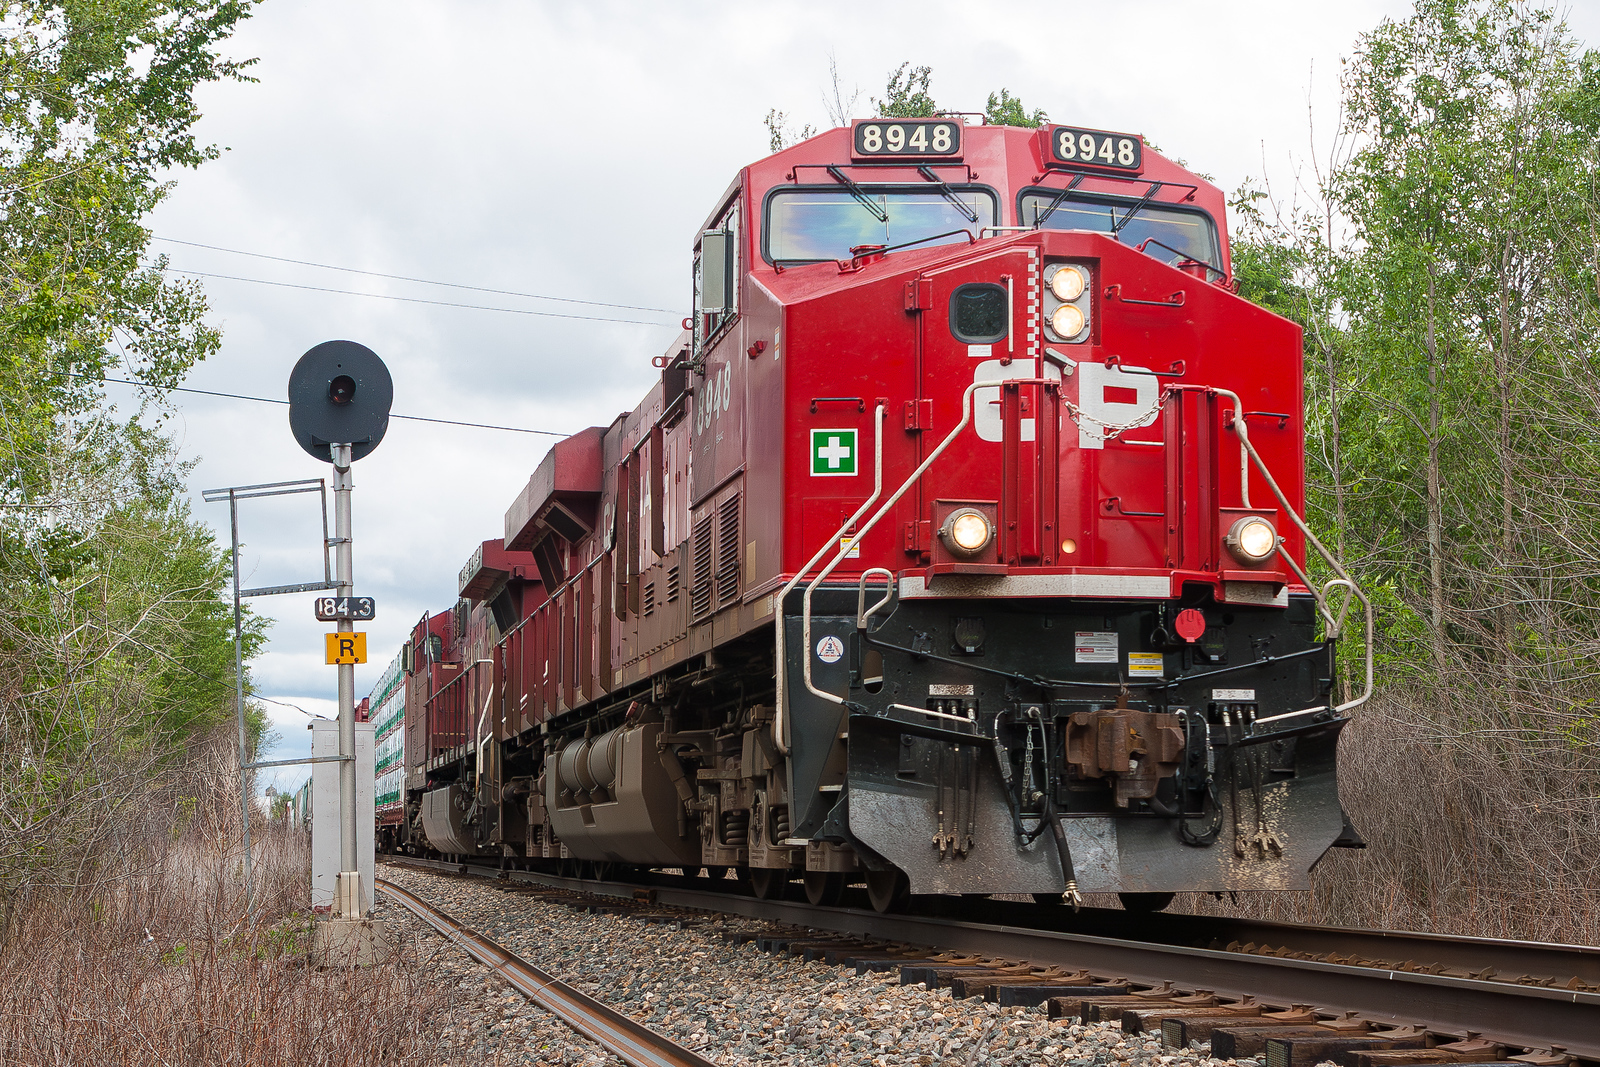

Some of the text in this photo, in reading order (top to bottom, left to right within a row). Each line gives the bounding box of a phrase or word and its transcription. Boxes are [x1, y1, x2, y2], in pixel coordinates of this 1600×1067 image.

[863, 124, 952, 152] 8948
[1059, 131, 1135, 166] 8948
[697, 360, 731, 436] 8948
[974, 358, 1160, 450] CP
[318, 598, 372, 616] 184.3
[339, 639, 355, 657] R
